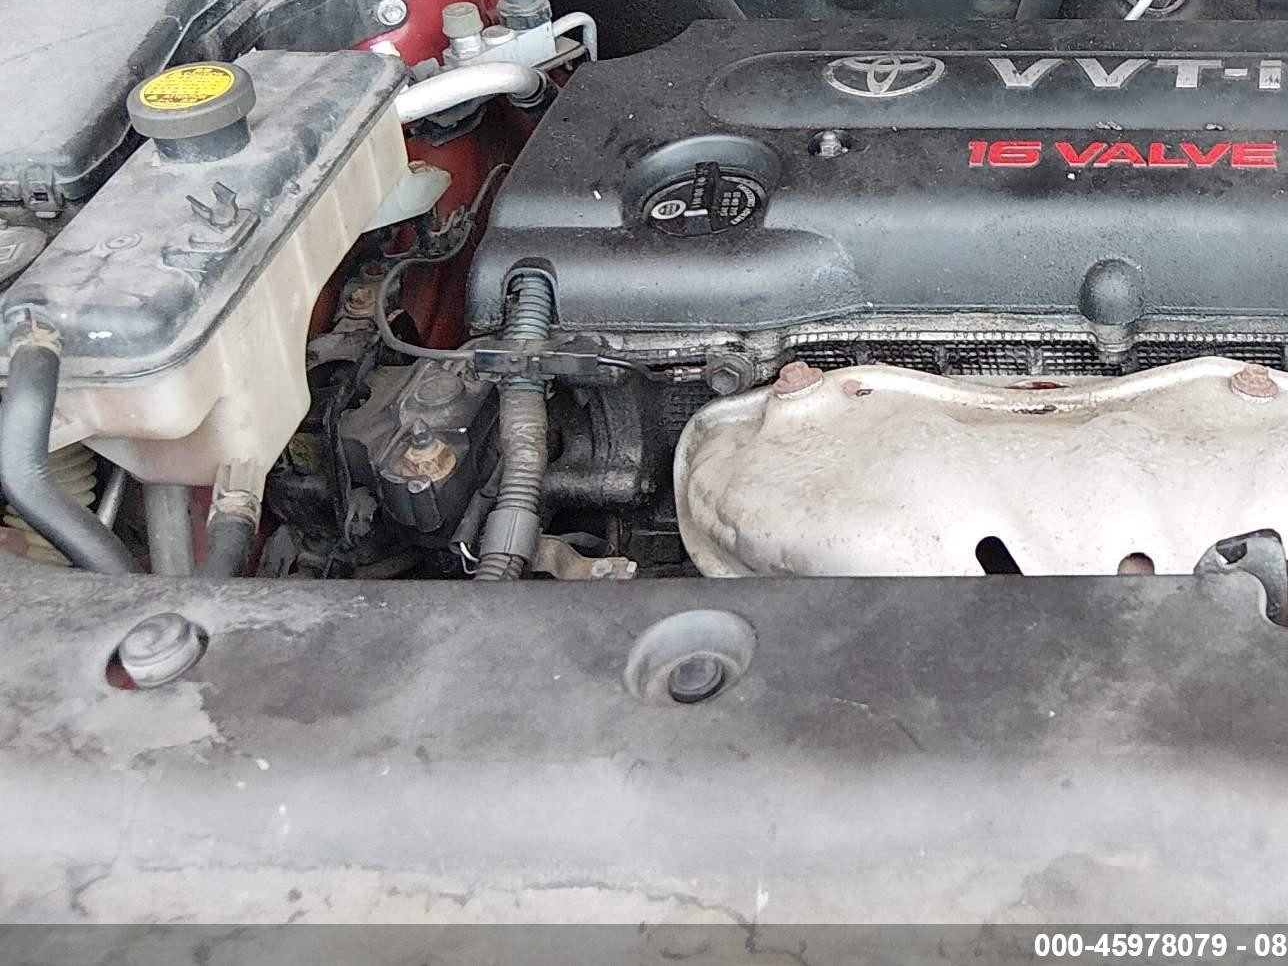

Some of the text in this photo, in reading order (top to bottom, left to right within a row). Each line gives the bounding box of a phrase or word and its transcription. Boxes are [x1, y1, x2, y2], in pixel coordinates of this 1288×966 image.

[988, 58, 1282, 89] VVT-i
[968, 141, 1277, 168] 16 VALVE
